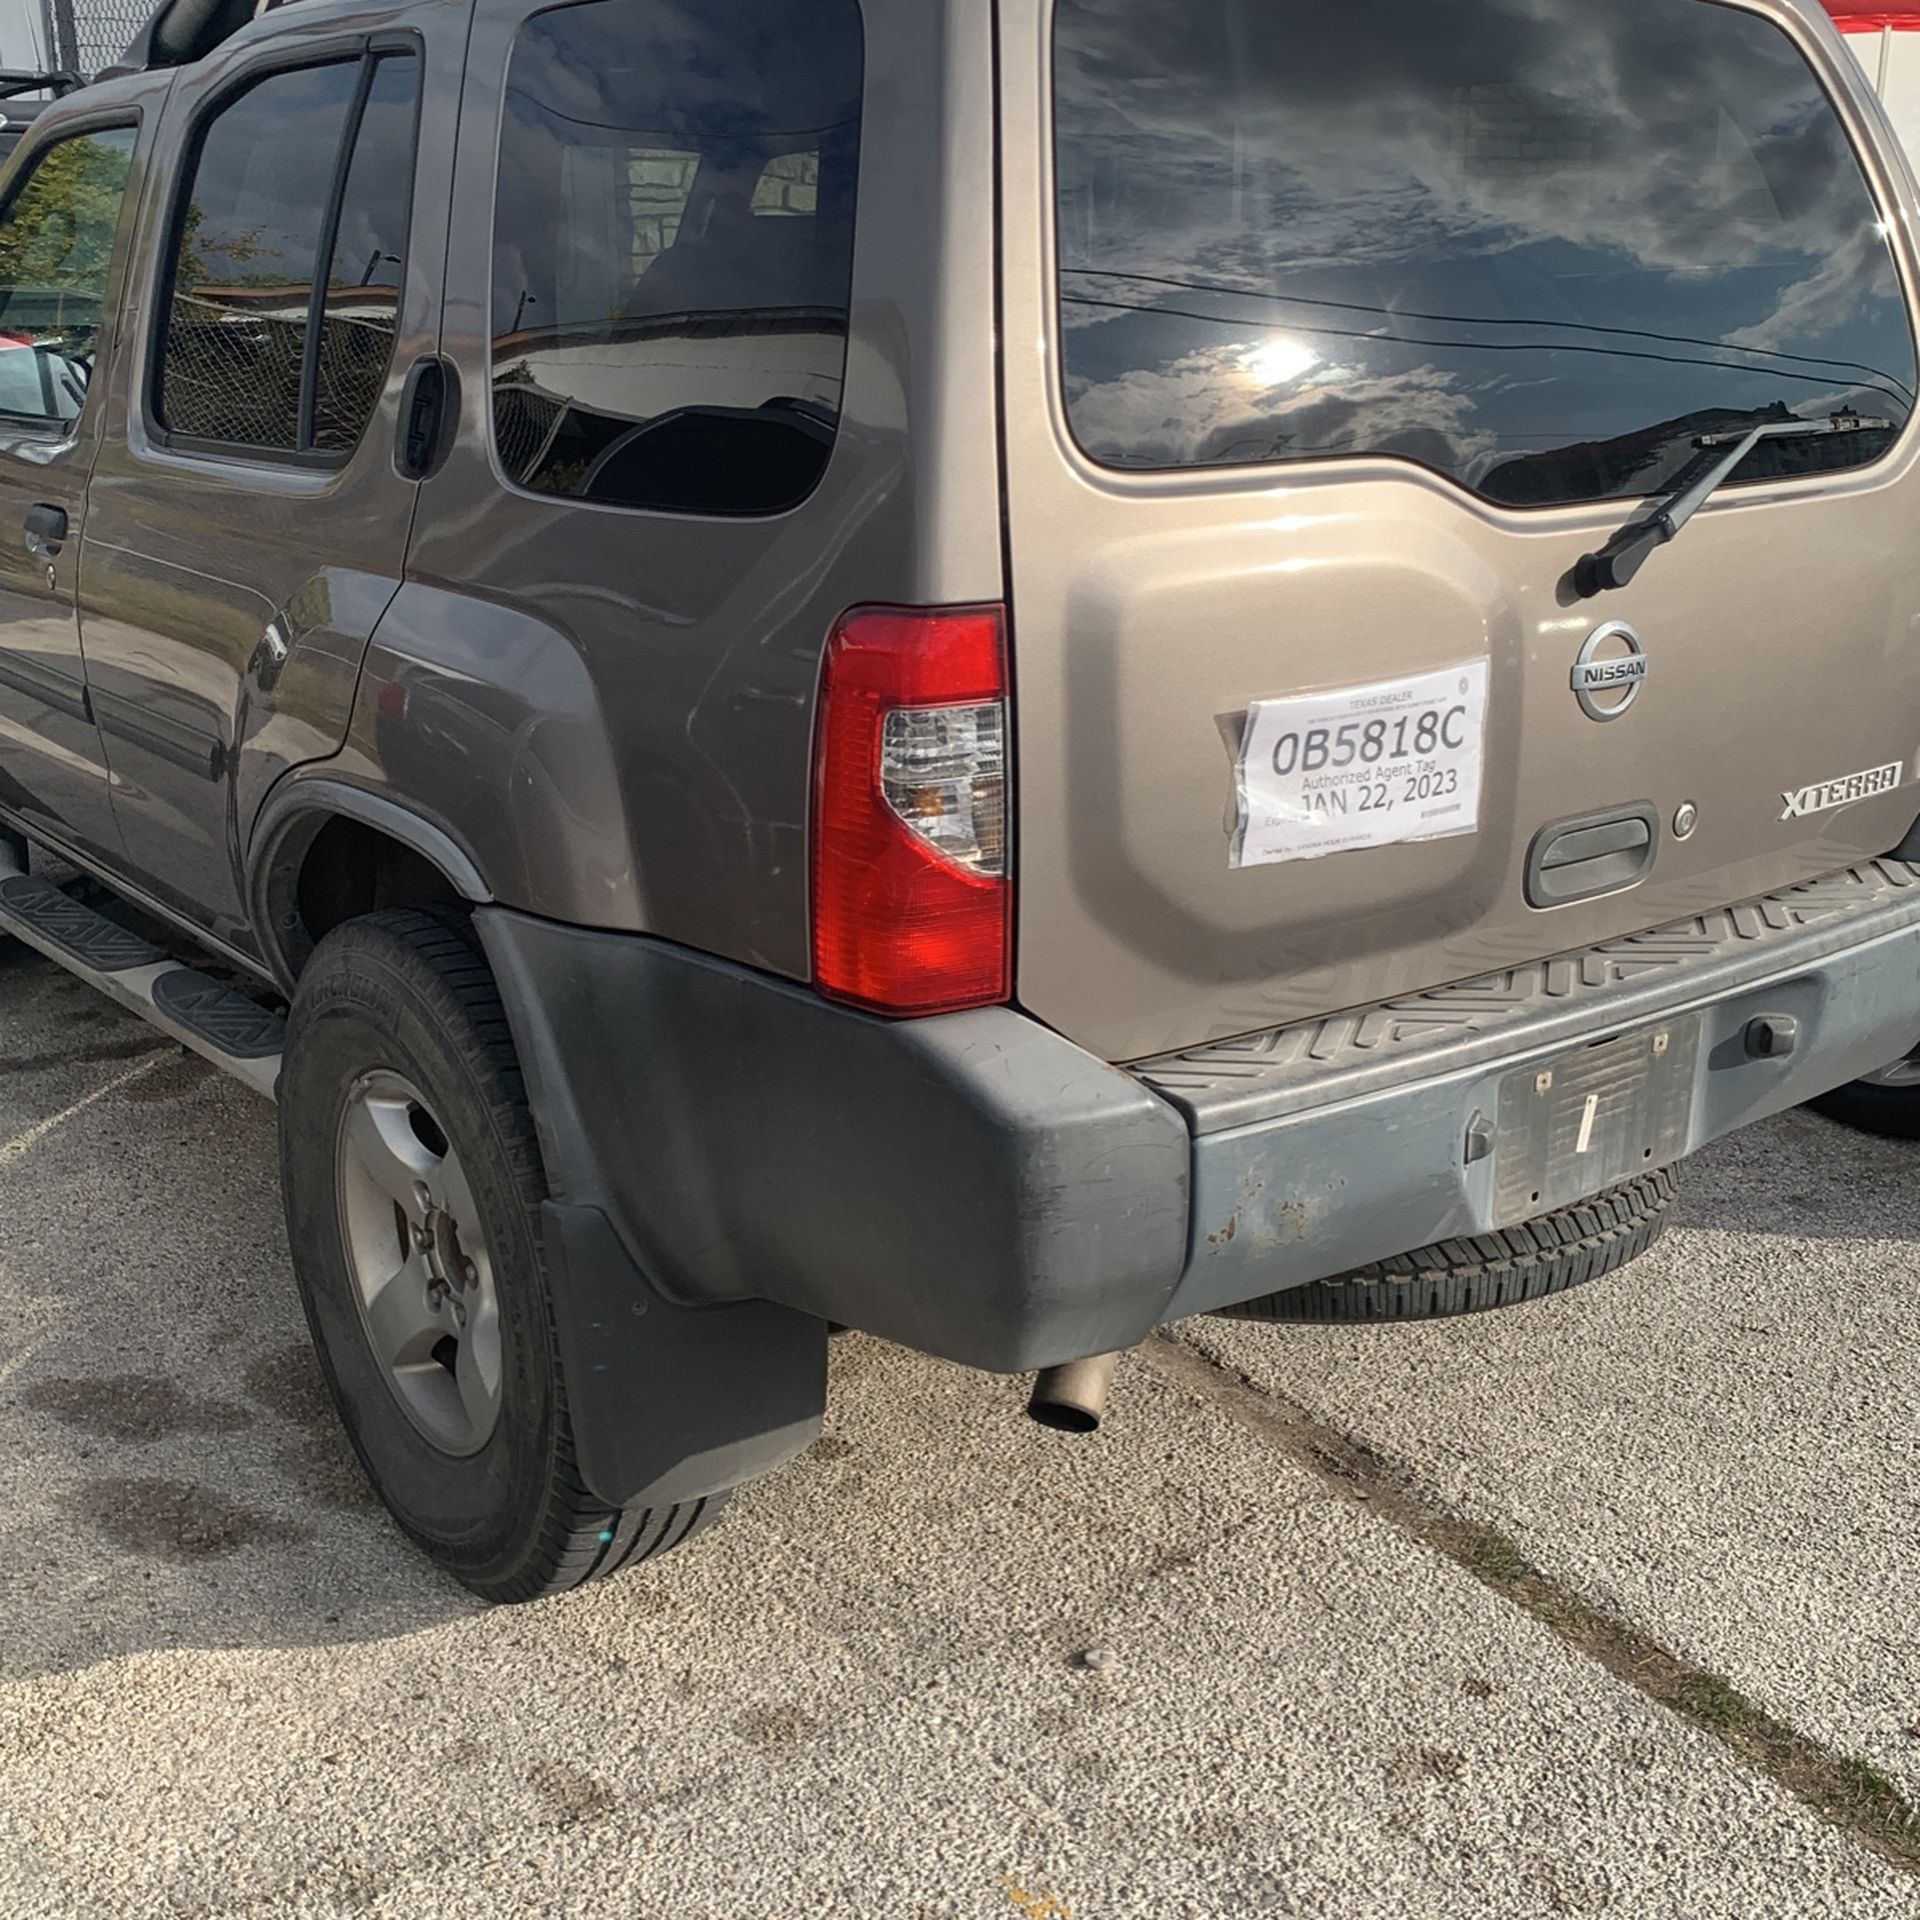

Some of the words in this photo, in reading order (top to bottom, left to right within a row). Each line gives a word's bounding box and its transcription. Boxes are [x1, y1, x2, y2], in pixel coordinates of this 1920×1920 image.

[1584, 661, 1646, 684] NISSAN
[1349, 695, 1378, 711] TEXAS
[1379, 690, 1414, 706] DEALER
[1272, 705, 1466, 777] 0B5818C
[1302, 770, 1372, 791] Authorized
[1375, 761, 1412, 783] Agent
[1416, 758, 1436, 775] Tag
[1302, 791, 1348, 817] JAN
[1358, 783, 1394, 812] 22,
[1403, 768, 1458, 802] 2023
[1777, 761, 1904, 822] XTERRA
